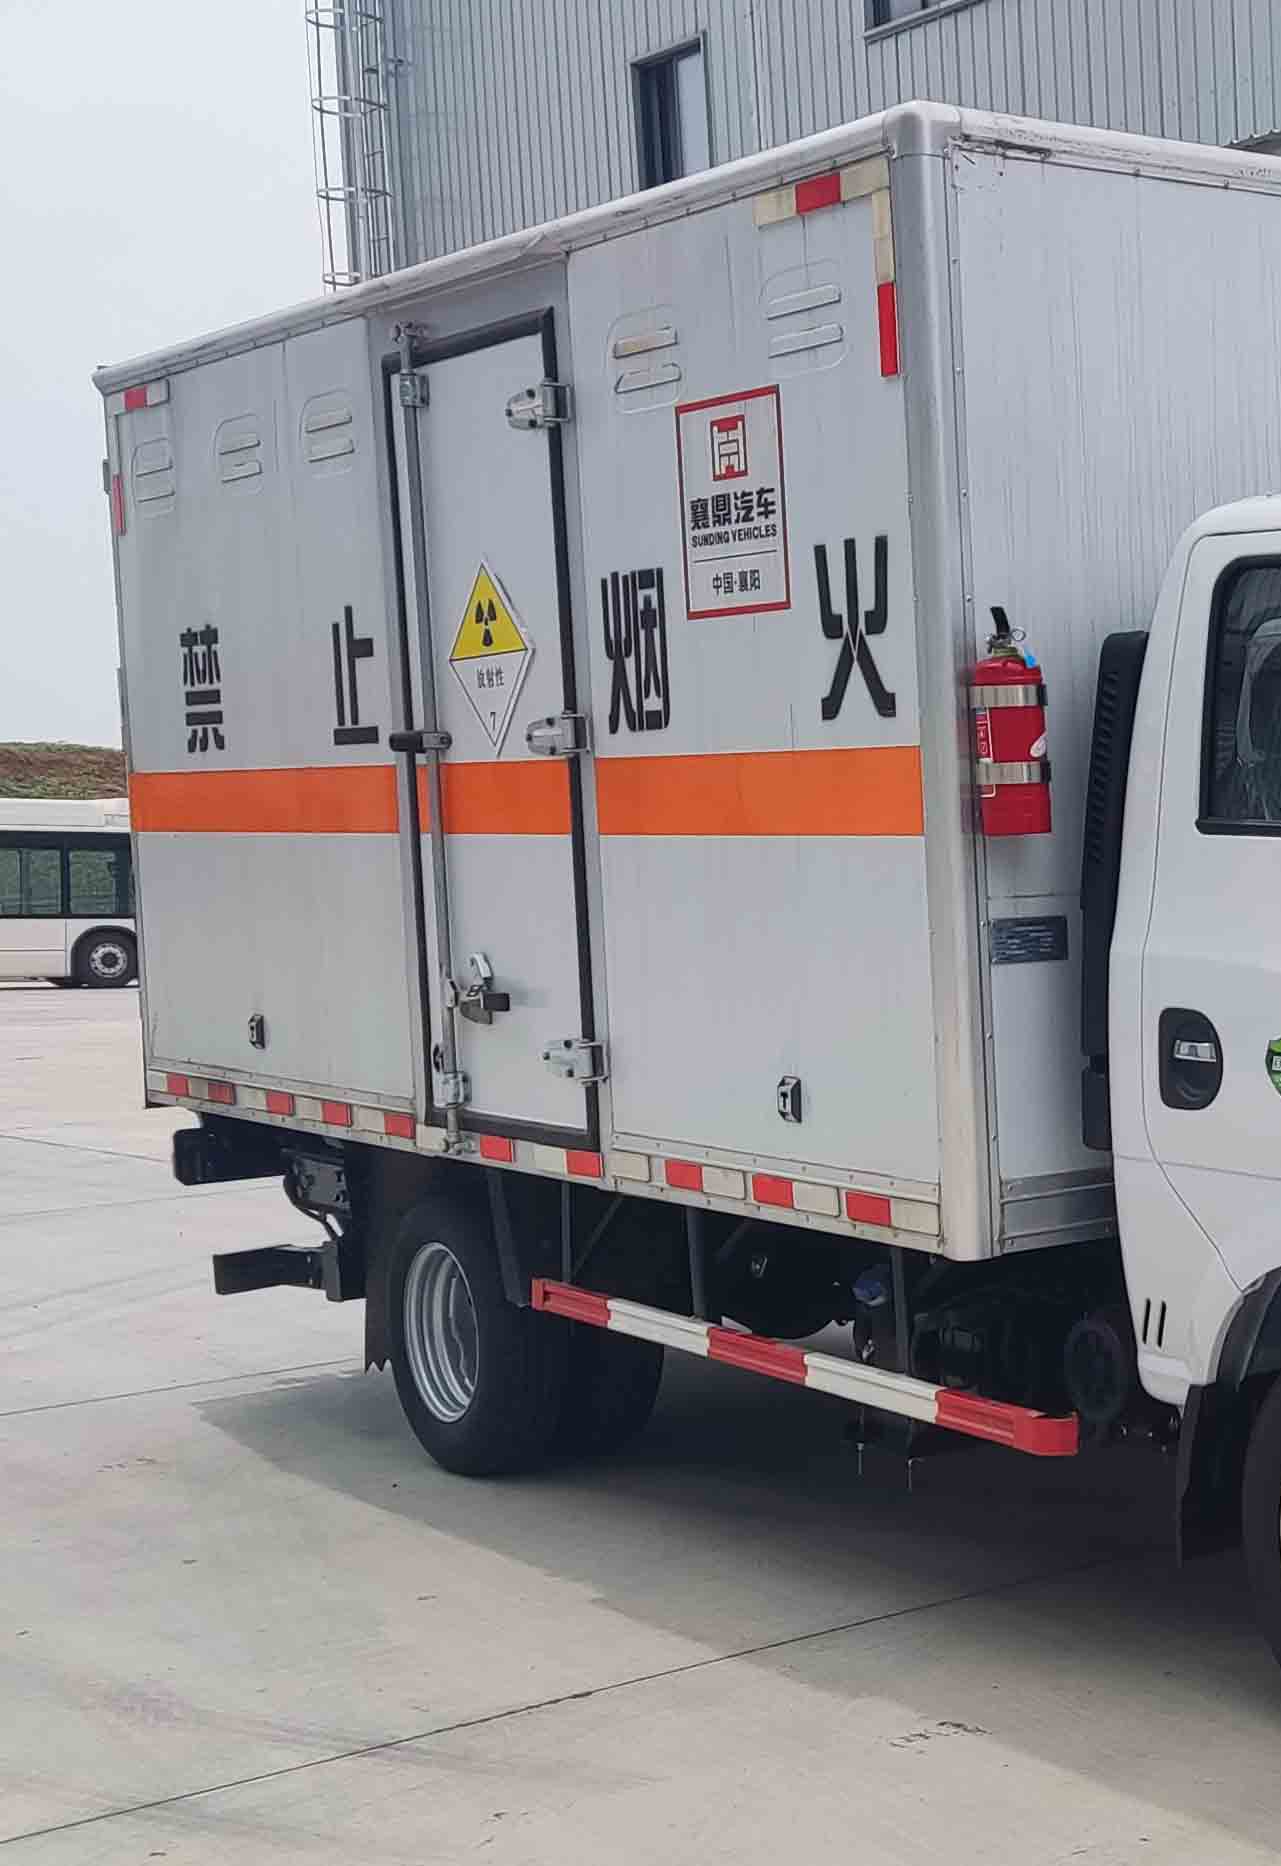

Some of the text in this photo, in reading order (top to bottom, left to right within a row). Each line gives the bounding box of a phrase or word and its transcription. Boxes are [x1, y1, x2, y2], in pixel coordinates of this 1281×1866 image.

[689, 486, 777, 531] 襄鼎汽车
[691, 523, 778, 548] SUNDING VEHICLES
[179, 535, 898, 753] 禁 止 烟 火
[489, 711, 497, 731] 7
